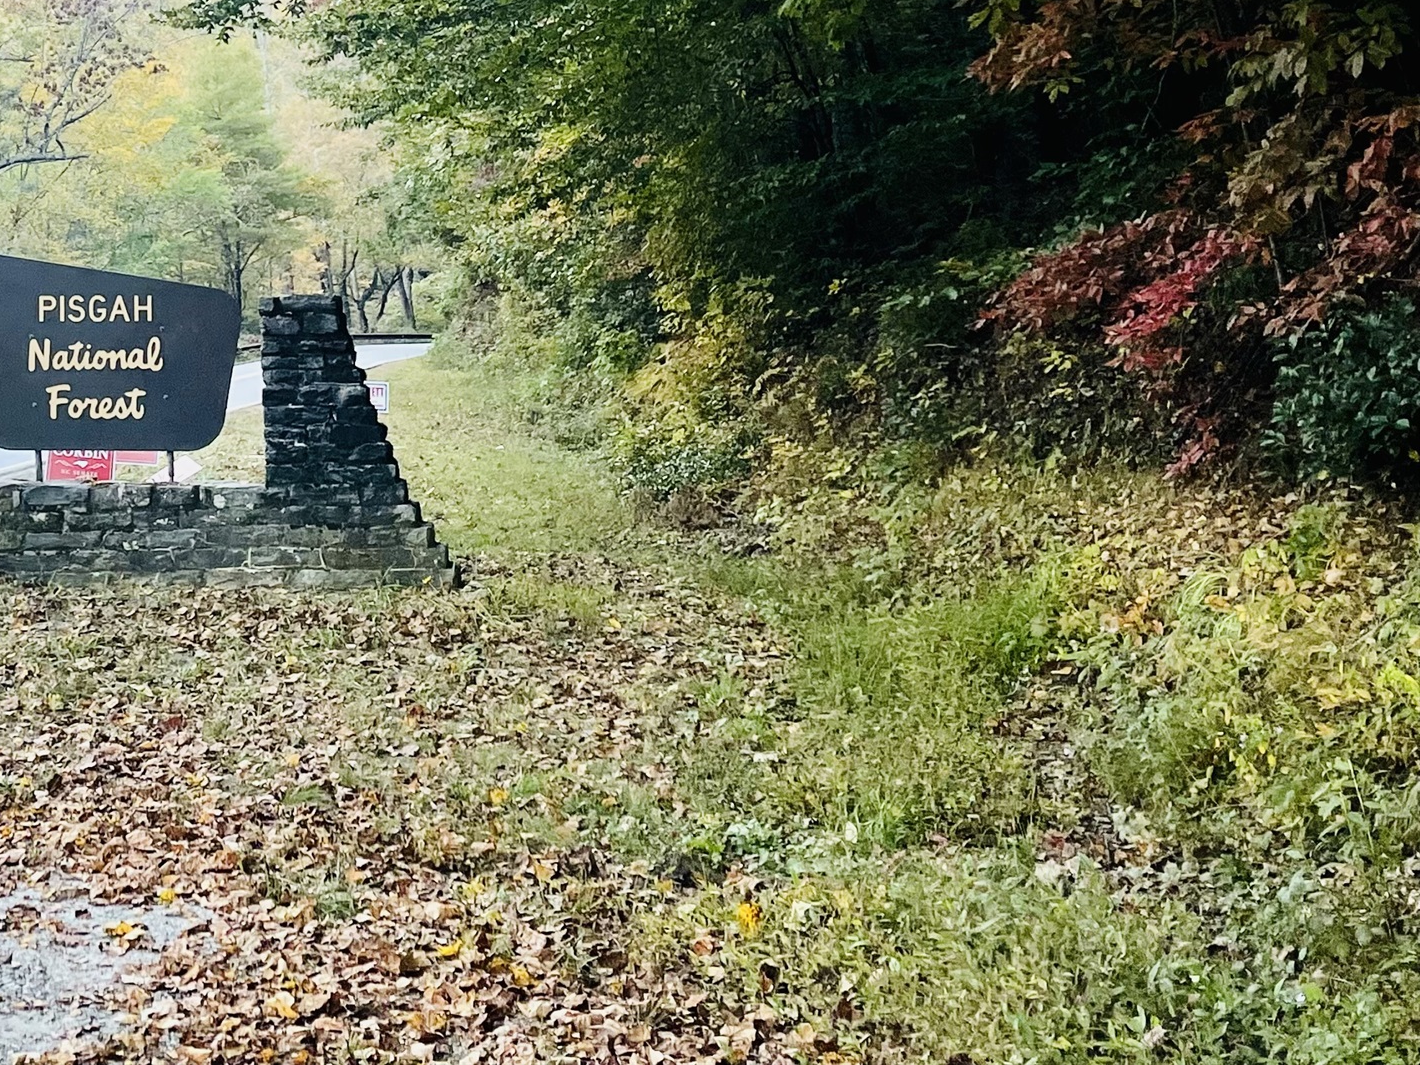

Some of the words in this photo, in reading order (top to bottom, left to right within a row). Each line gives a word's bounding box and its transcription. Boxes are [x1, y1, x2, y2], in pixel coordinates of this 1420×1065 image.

[38, 294, 153, 323] PISGAH
[28, 336, 163, 372] National
[46, 384, 147, 420] Forest
